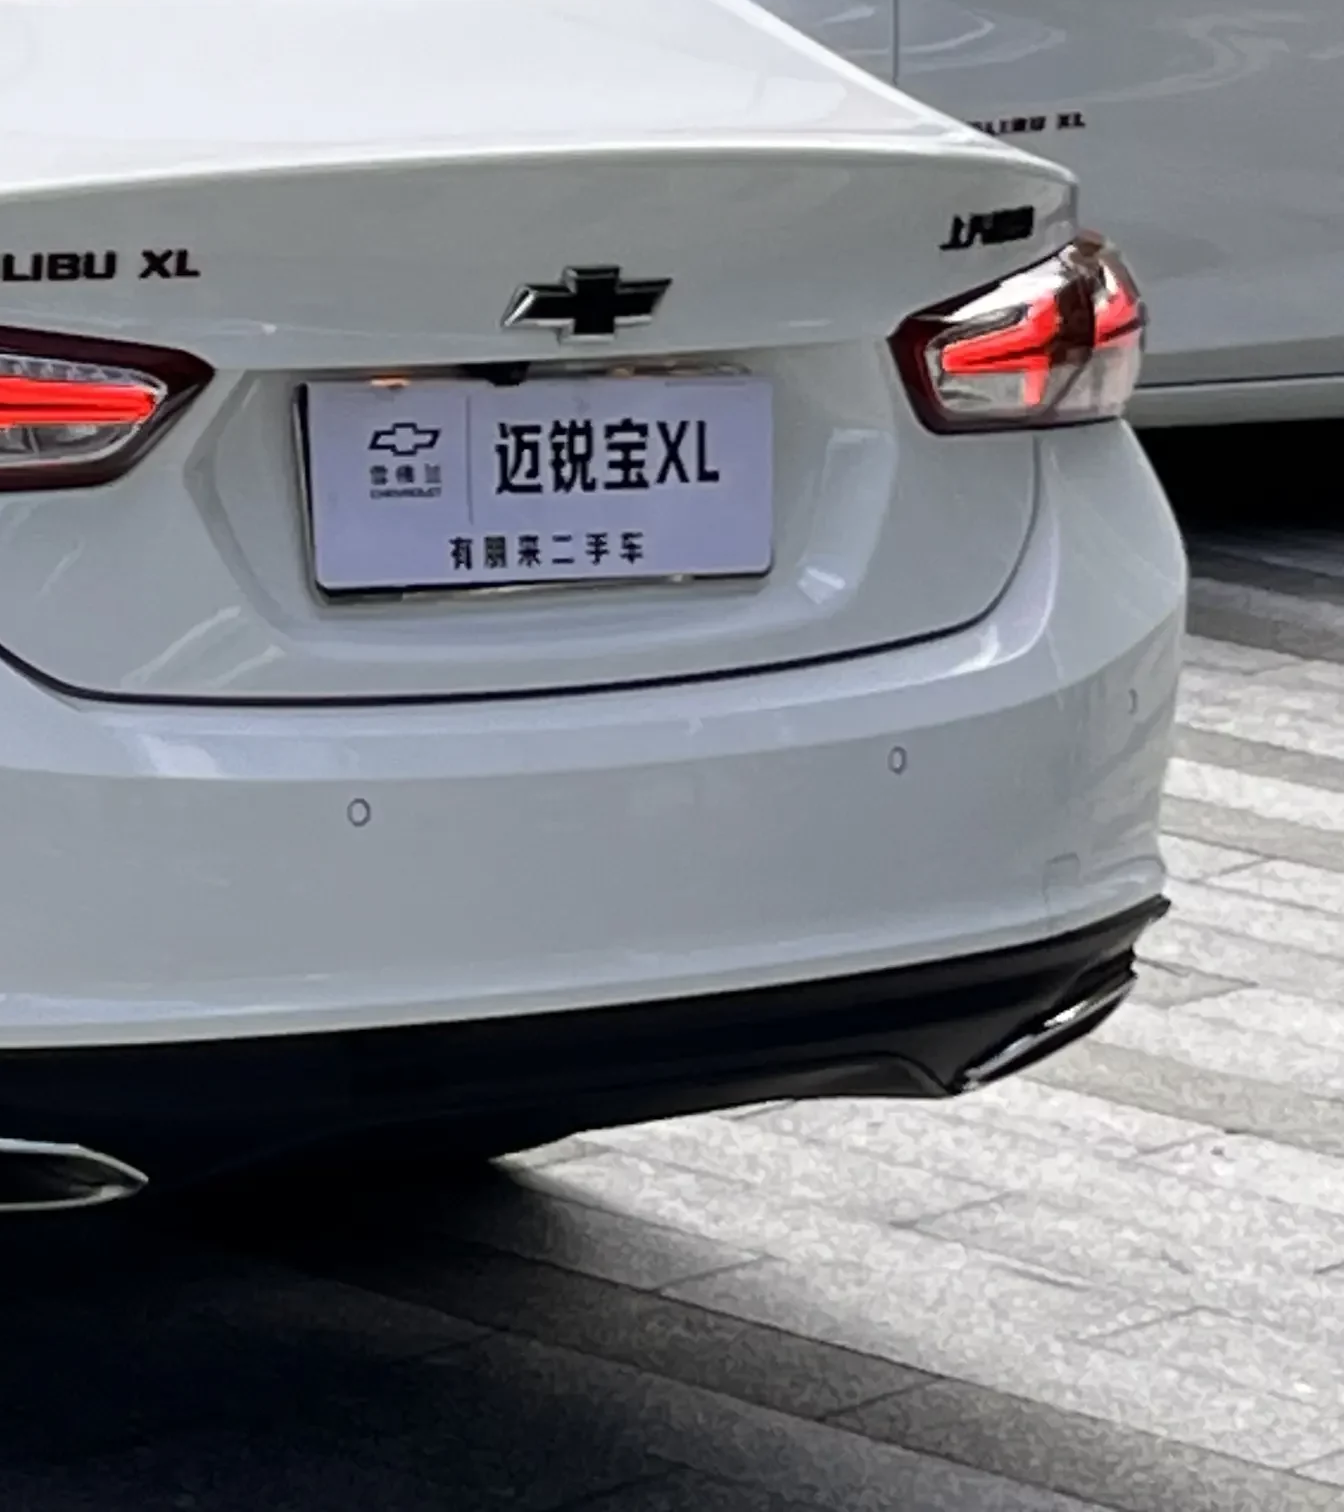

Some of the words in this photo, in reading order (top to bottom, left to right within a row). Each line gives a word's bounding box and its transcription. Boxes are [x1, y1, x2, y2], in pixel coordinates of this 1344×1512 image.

[138, 249, 201, 280] XL
[495, 417, 720, 494] 迈锐宝XL
